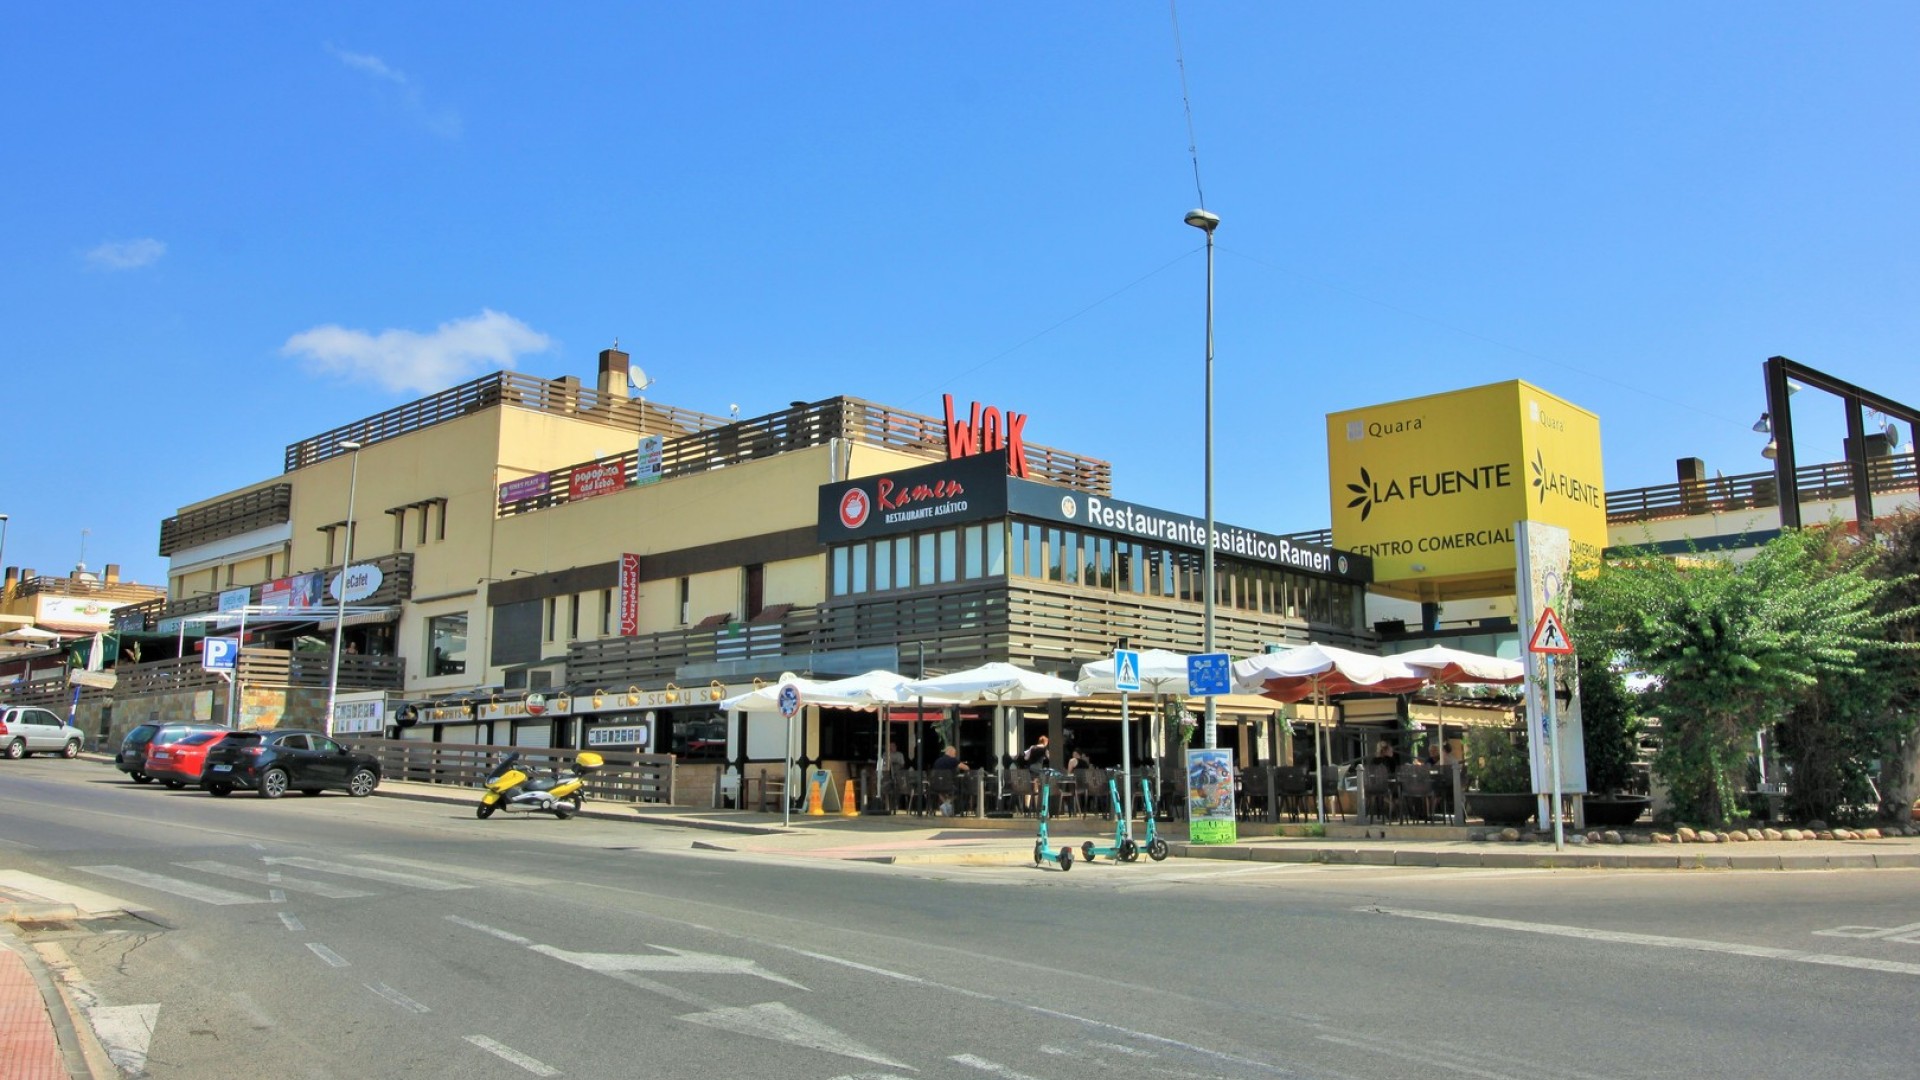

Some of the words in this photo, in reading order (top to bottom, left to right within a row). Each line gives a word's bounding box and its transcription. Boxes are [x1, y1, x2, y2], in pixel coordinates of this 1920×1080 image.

[943, 393, 1029, 478] WOK
[1368, 418, 1423, 438] Quara
[1540, 410, 1564, 432] Quara
[878, 478, 965, 512] Ramen
[1373, 479, 1405, 504] LA
[1409, 463, 1511, 499] FUENTE
[1543, 467, 1559, 494] LA
[1559, 474, 1600, 509] FUENTE
[885, 507, 934, 524] RESTAURANTE
[934, 500, 968, 516] ASIÁTICO
[1087, 497, 1206, 546] Restaurante
[1212, 528, 1278, 561] asiático
[1279, 539, 1332, 572] Ramen
[1418, 527, 1516, 553] COMERCIAL
[206, 640, 229, 667] P
